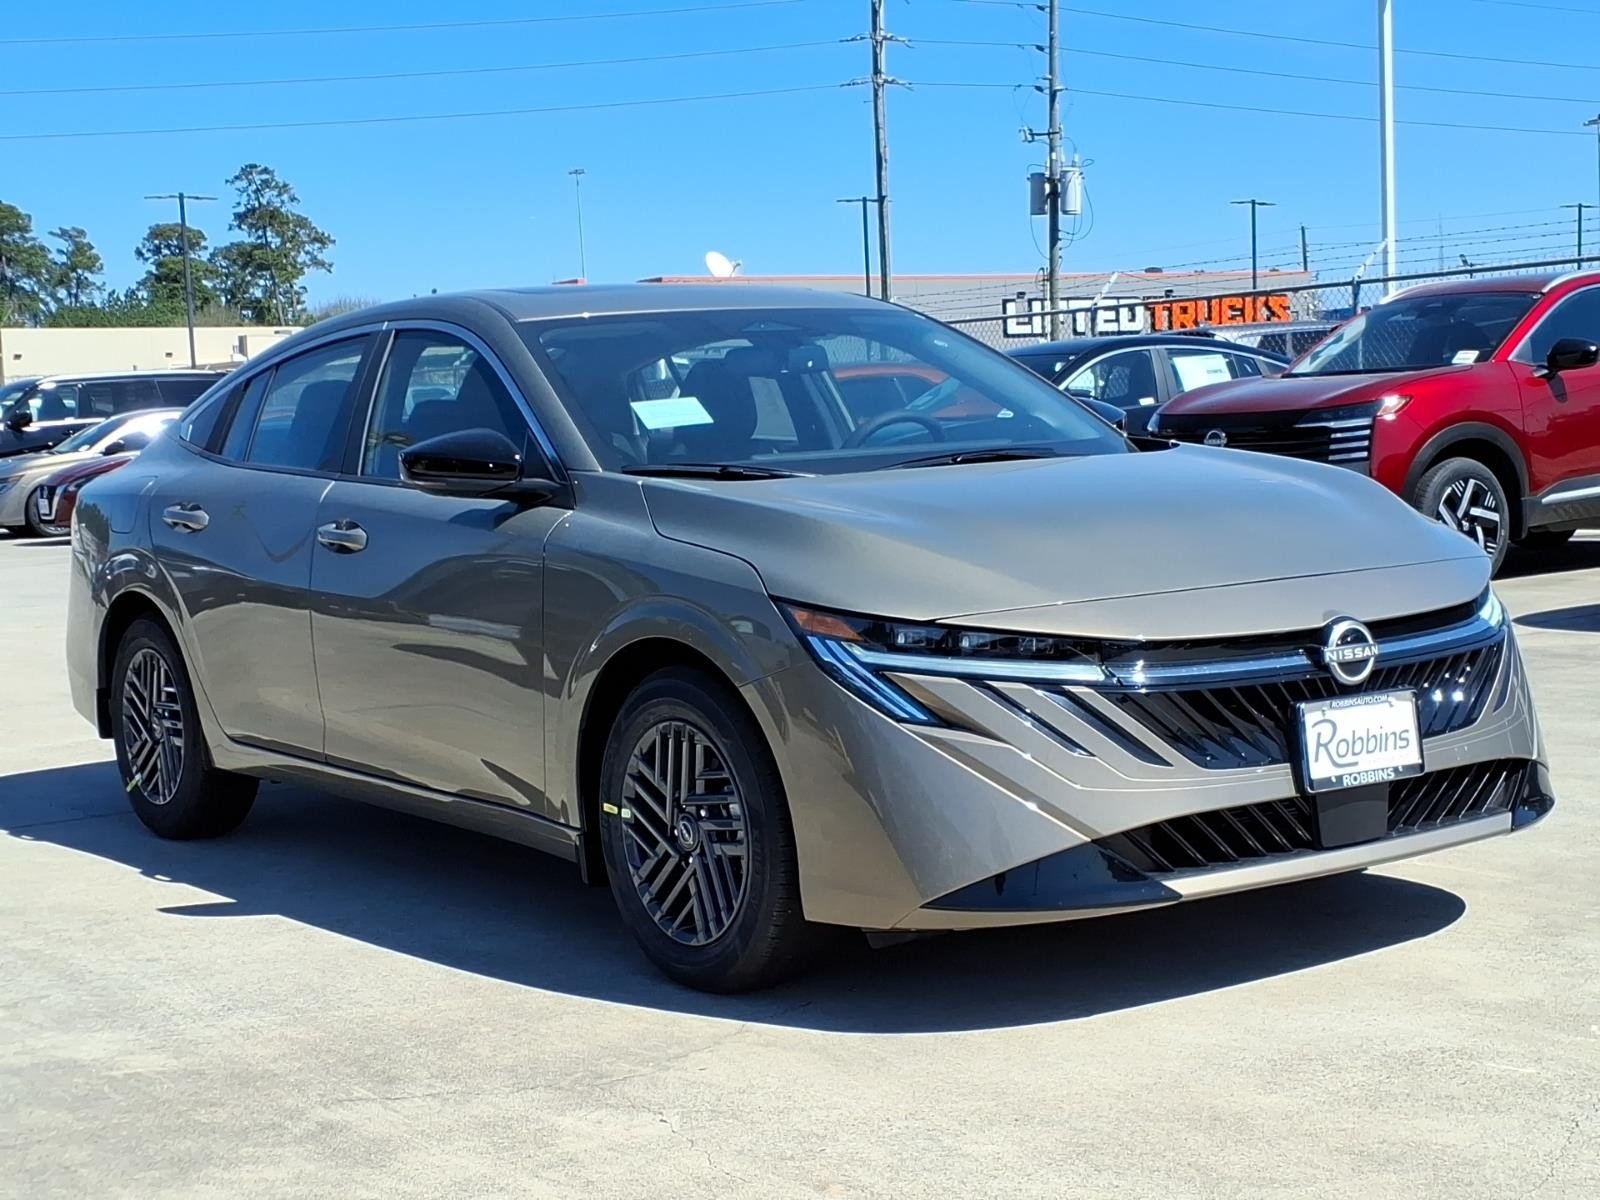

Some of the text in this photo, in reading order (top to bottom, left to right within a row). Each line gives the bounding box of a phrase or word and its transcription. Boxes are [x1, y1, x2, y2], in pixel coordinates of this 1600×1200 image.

[1149, 293, 1291, 331] TRUCKS
[1324, 644, 1379, 662] NISSAN
[1311, 718, 1410, 768] Robbins
[1342, 767, 1395, 787] ROBBINS
